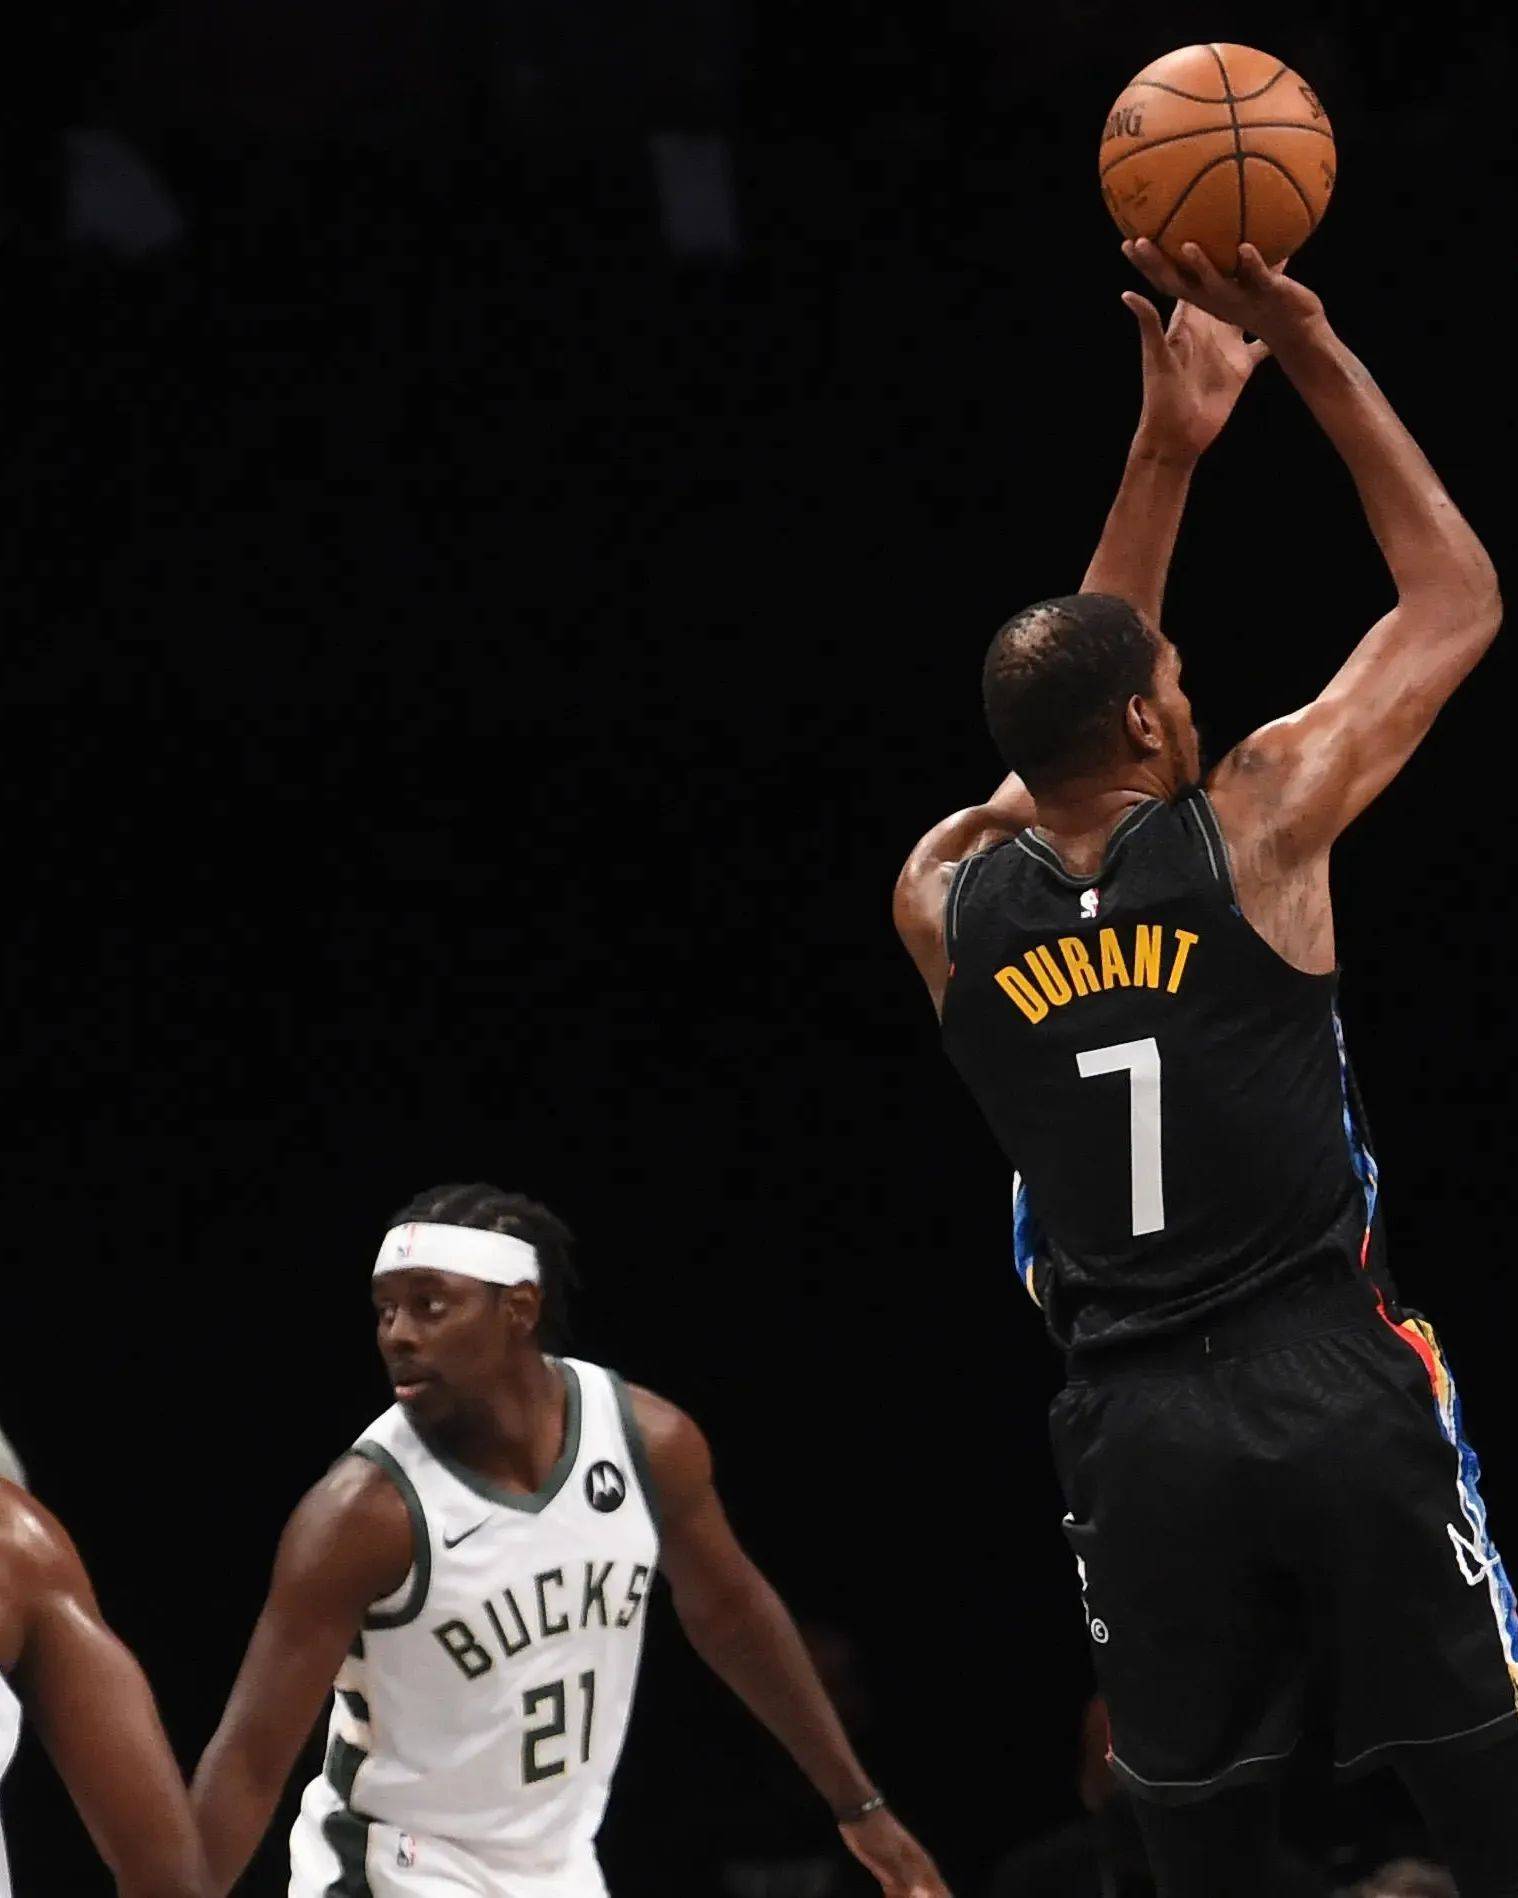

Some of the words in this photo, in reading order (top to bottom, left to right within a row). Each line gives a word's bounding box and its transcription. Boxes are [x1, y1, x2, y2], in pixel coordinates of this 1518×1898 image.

[994, 924, 1199, 1025] DURANT
[1076, 1037, 1165, 1236] 7
[431, 1560, 649, 1681] BUCKS
[521, 1668, 597, 1787] 21
